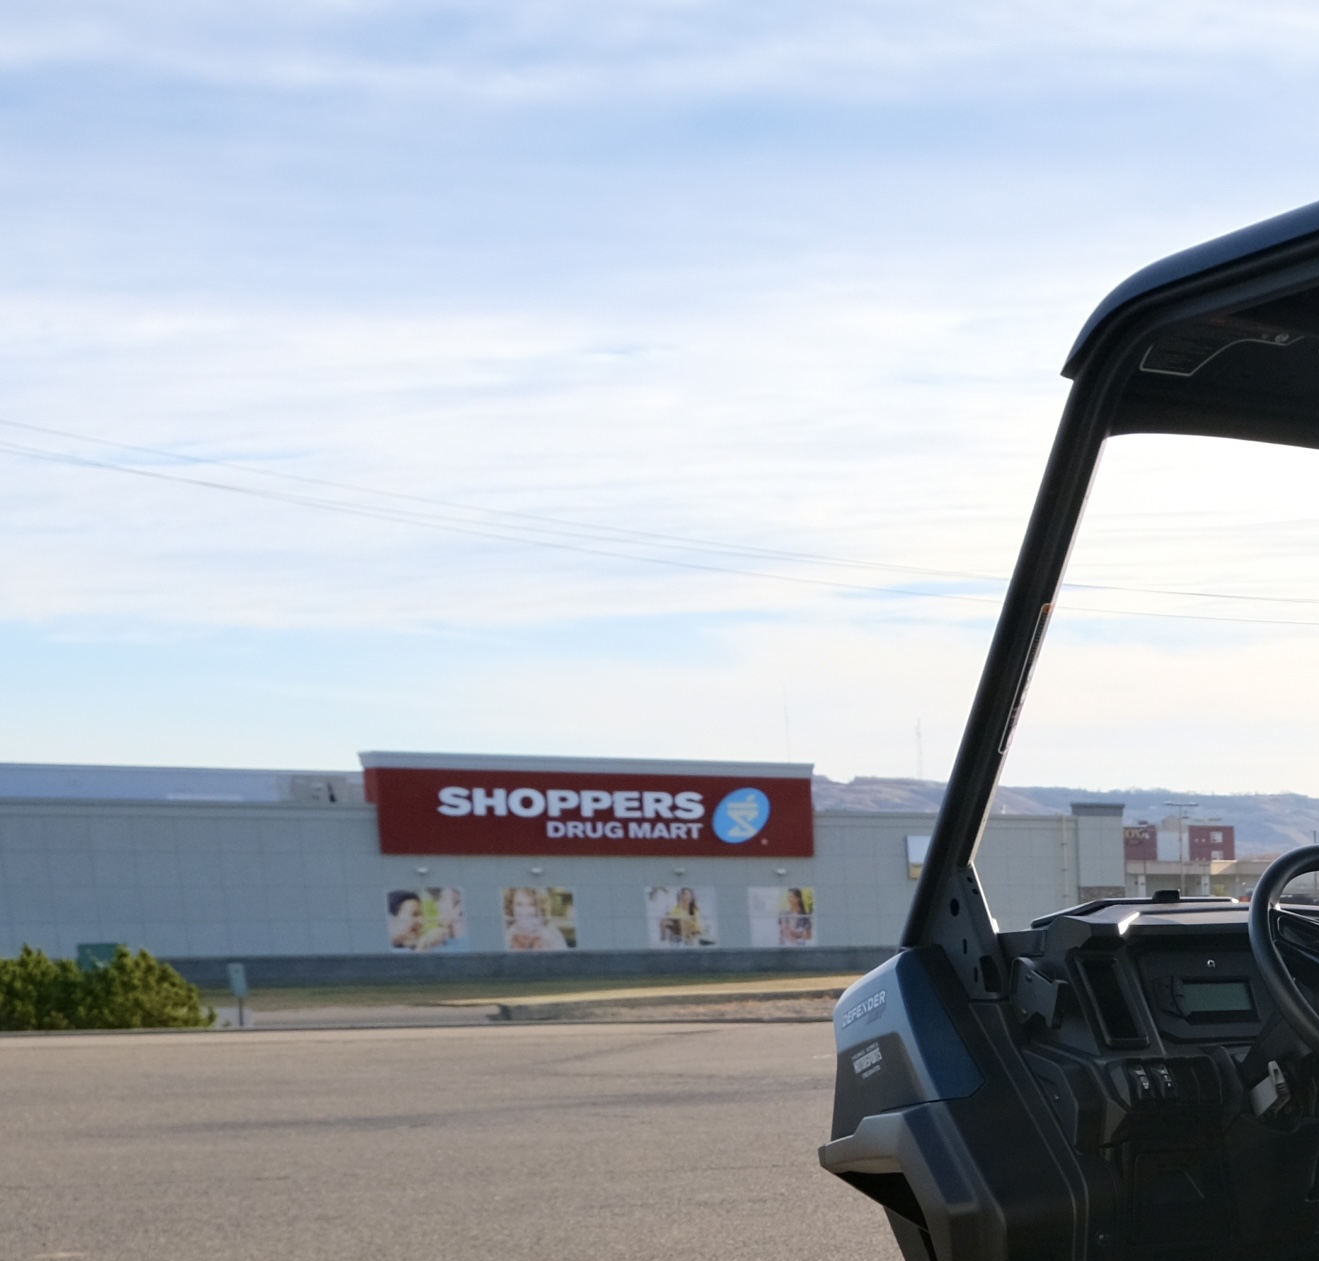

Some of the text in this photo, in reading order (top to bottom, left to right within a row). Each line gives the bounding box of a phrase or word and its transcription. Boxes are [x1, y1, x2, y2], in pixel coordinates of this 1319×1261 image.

[437, 786, 705, 820] SHOPPERS
[546, 820, 703, 839] DRUG MART
[842, 989, 886, 1028] DEFENDER
